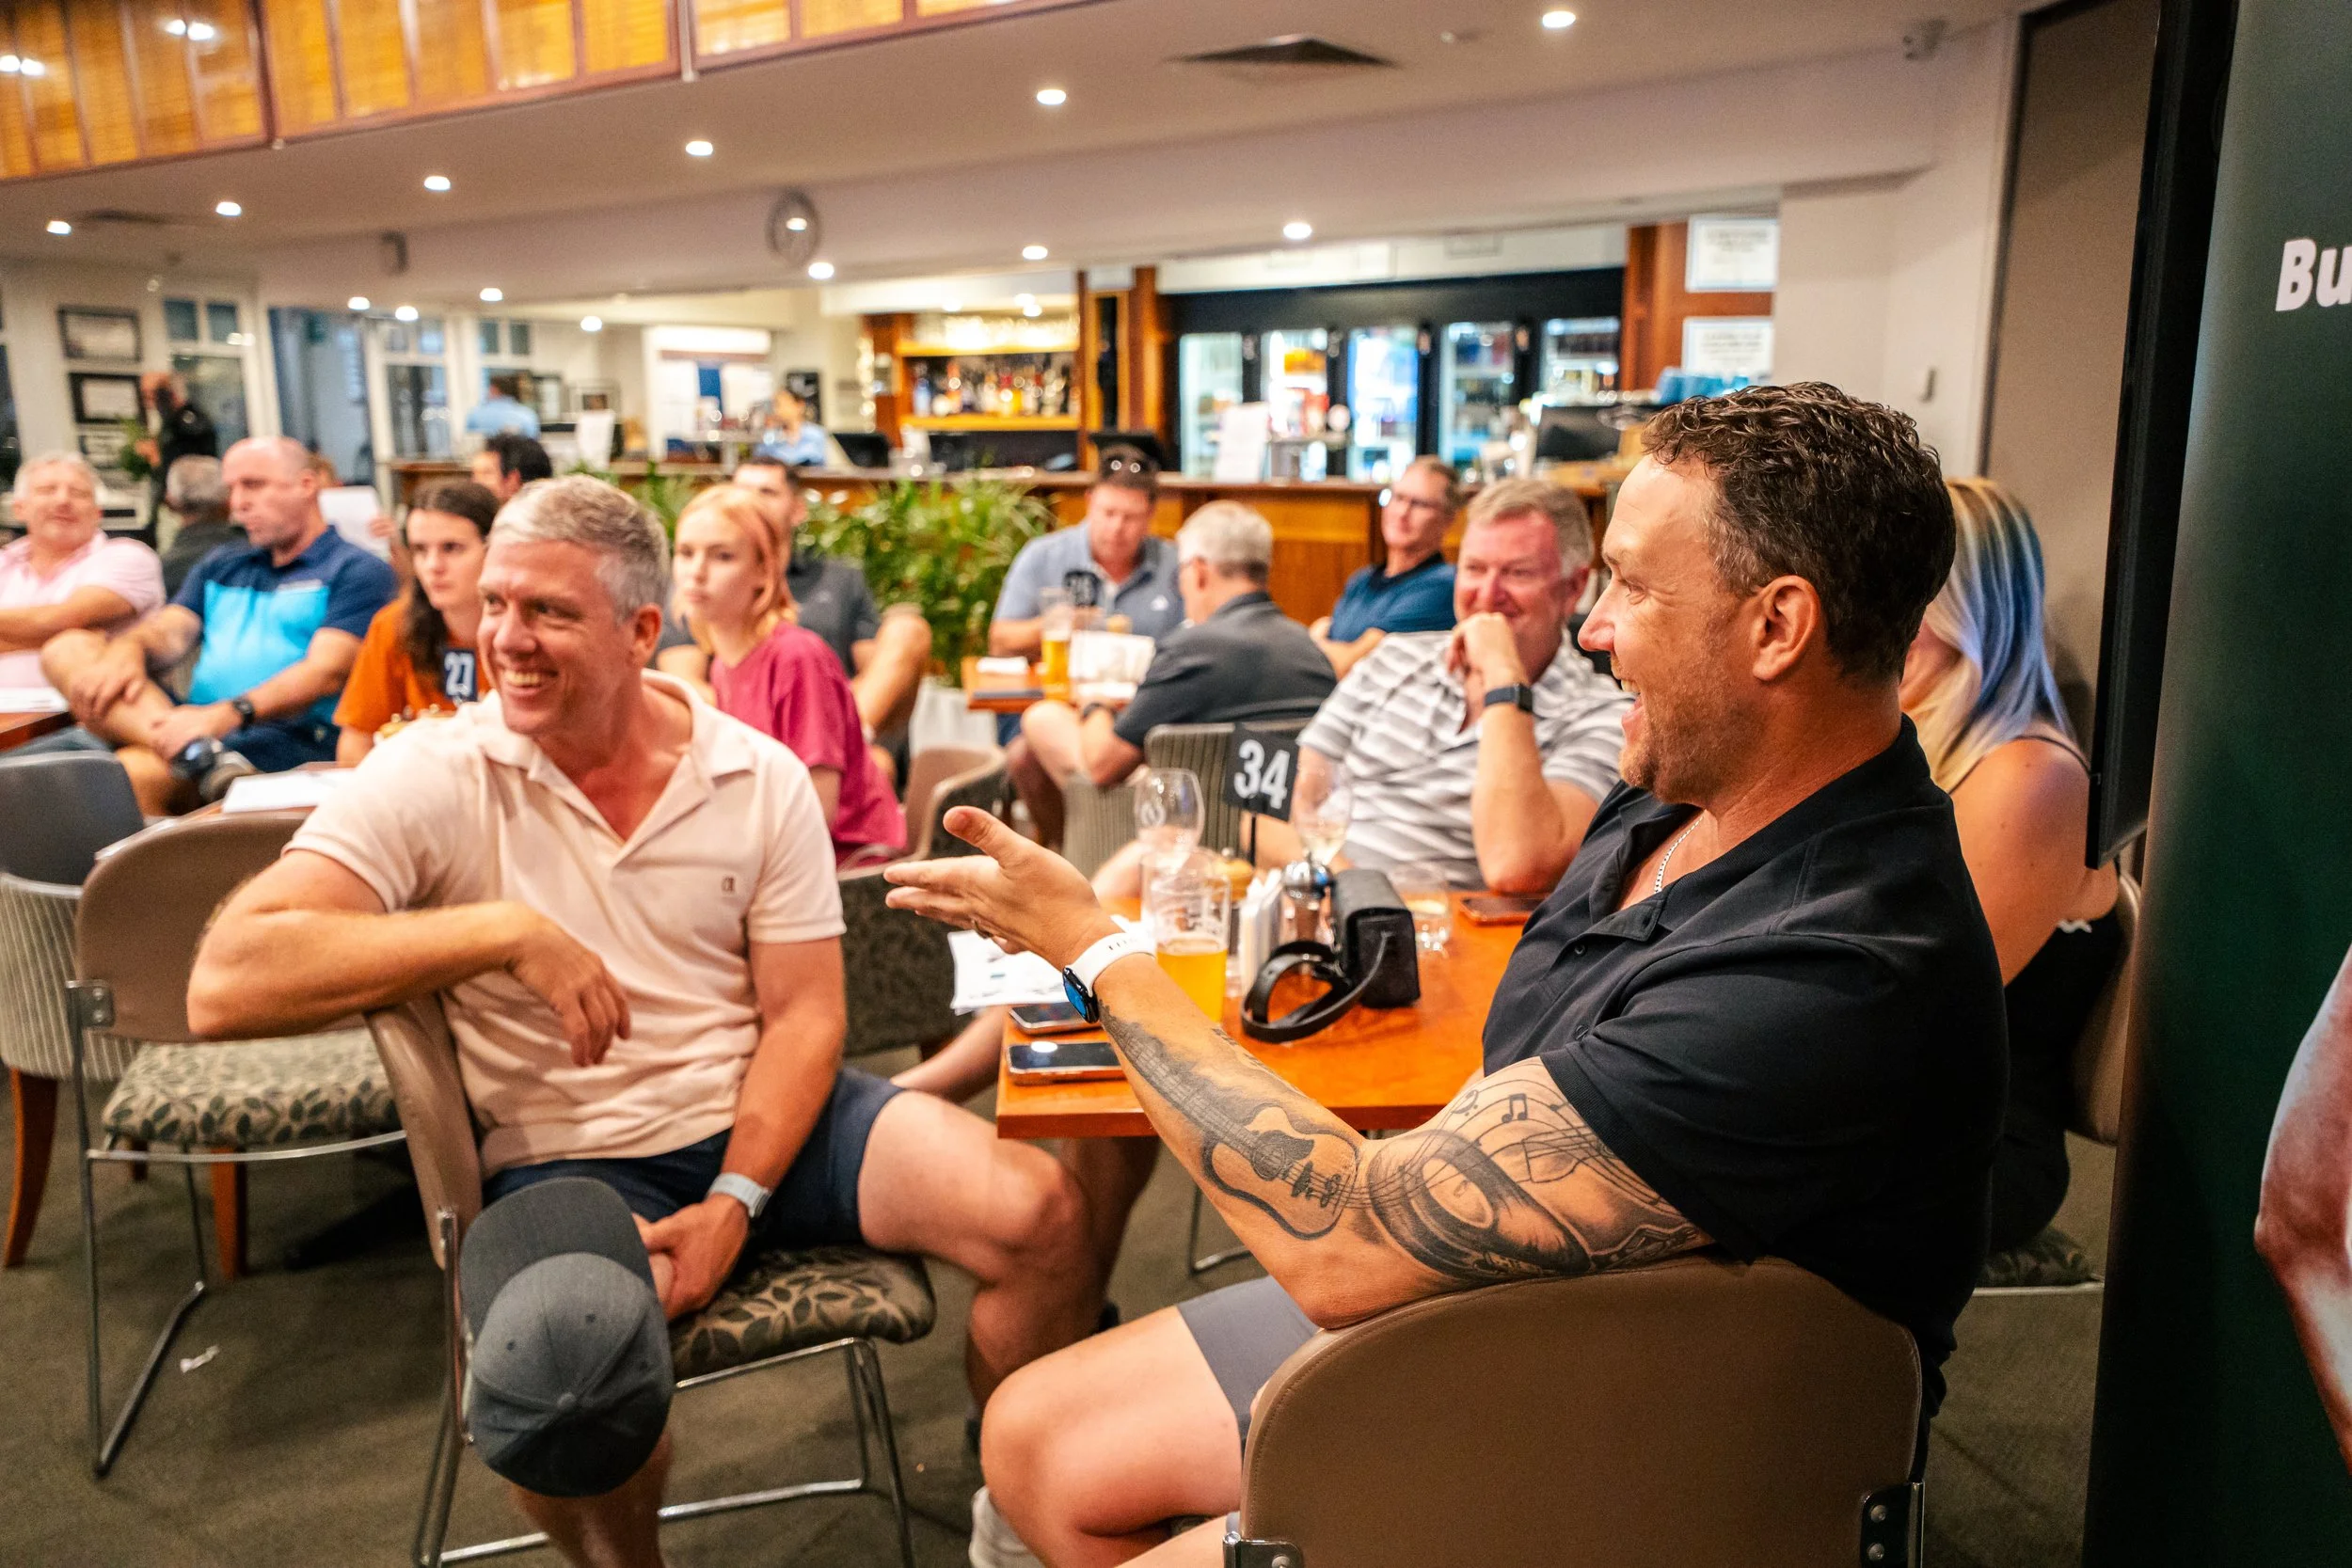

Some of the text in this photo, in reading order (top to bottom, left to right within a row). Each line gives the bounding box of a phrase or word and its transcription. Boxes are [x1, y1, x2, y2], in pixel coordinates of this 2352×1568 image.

[2276, 238, 2352, 311] Bu
[444, 652, 474, 696] 27
[1234, 739, 1290, 809] 34
